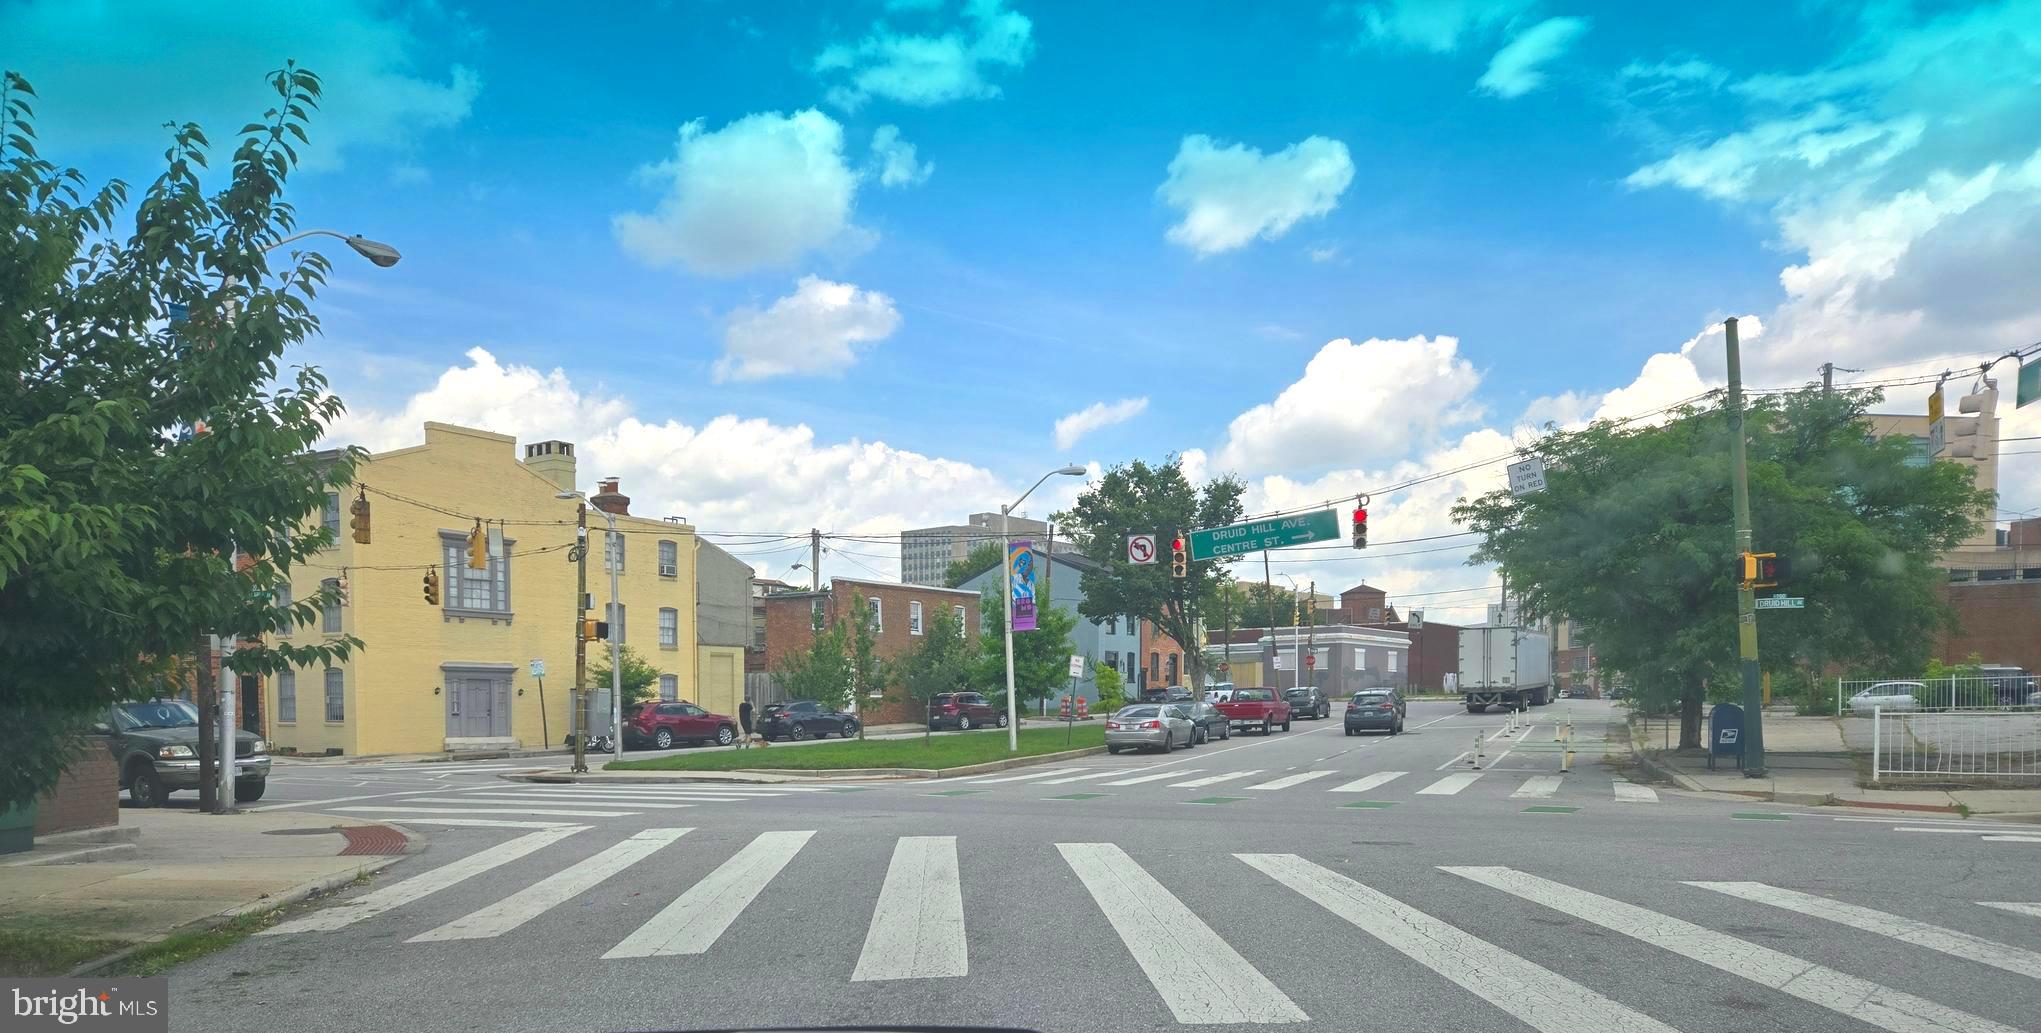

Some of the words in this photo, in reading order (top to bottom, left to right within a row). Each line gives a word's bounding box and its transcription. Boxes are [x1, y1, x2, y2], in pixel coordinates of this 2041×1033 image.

[1519, 464, 1531, 472] NO
[1517, 472, 1537, 482] TURN
[1528, 479, 1543, 488] RED
[1212, 528, 1247, 541] DRUID
[1251, 523, 1276, 535] HILL
[1281, 518, 1311, 530] AVE.
[1213, 540, 1258, 554] CENTRE
[1264, 536, 1284, 547] ST.
